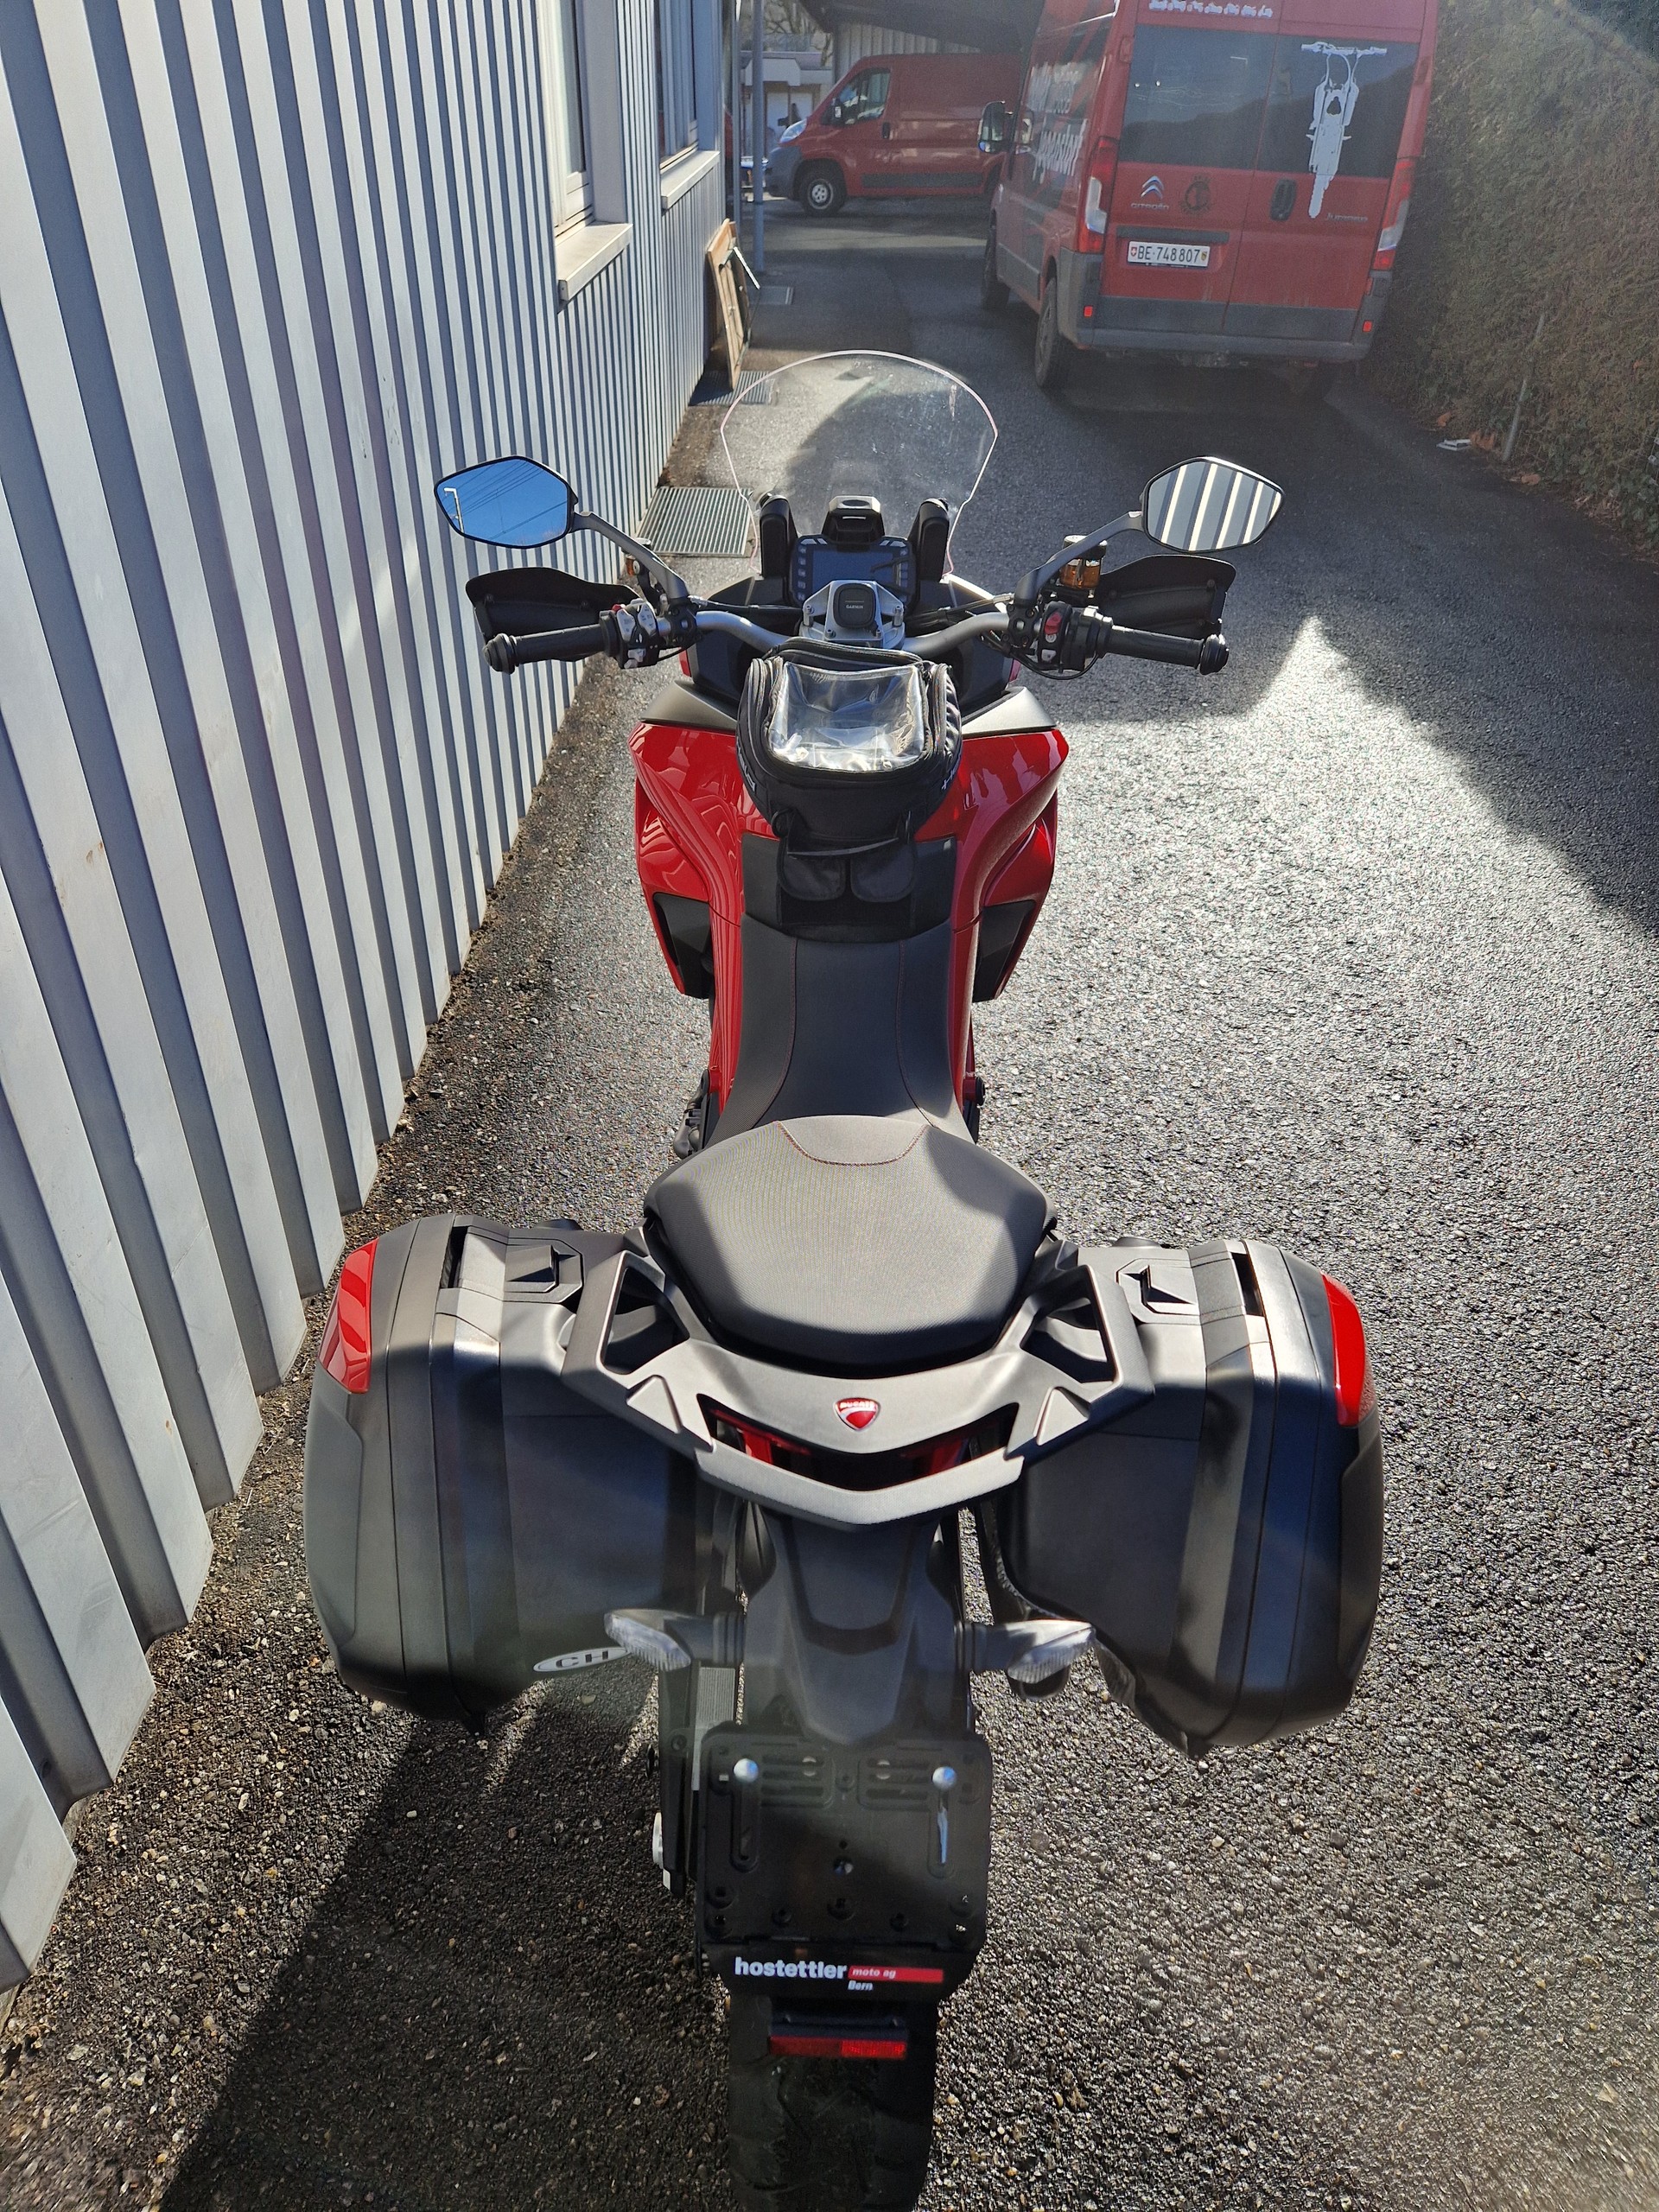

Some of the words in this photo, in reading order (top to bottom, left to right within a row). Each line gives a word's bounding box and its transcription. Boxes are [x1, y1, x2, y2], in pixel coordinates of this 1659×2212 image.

[734, 1956, 847, 1980] hostettler
[852, 1967, 880, 1977] moto
[882, 1968, 897, 1980] ag
[848, 1980, 874, 1991] Bern
